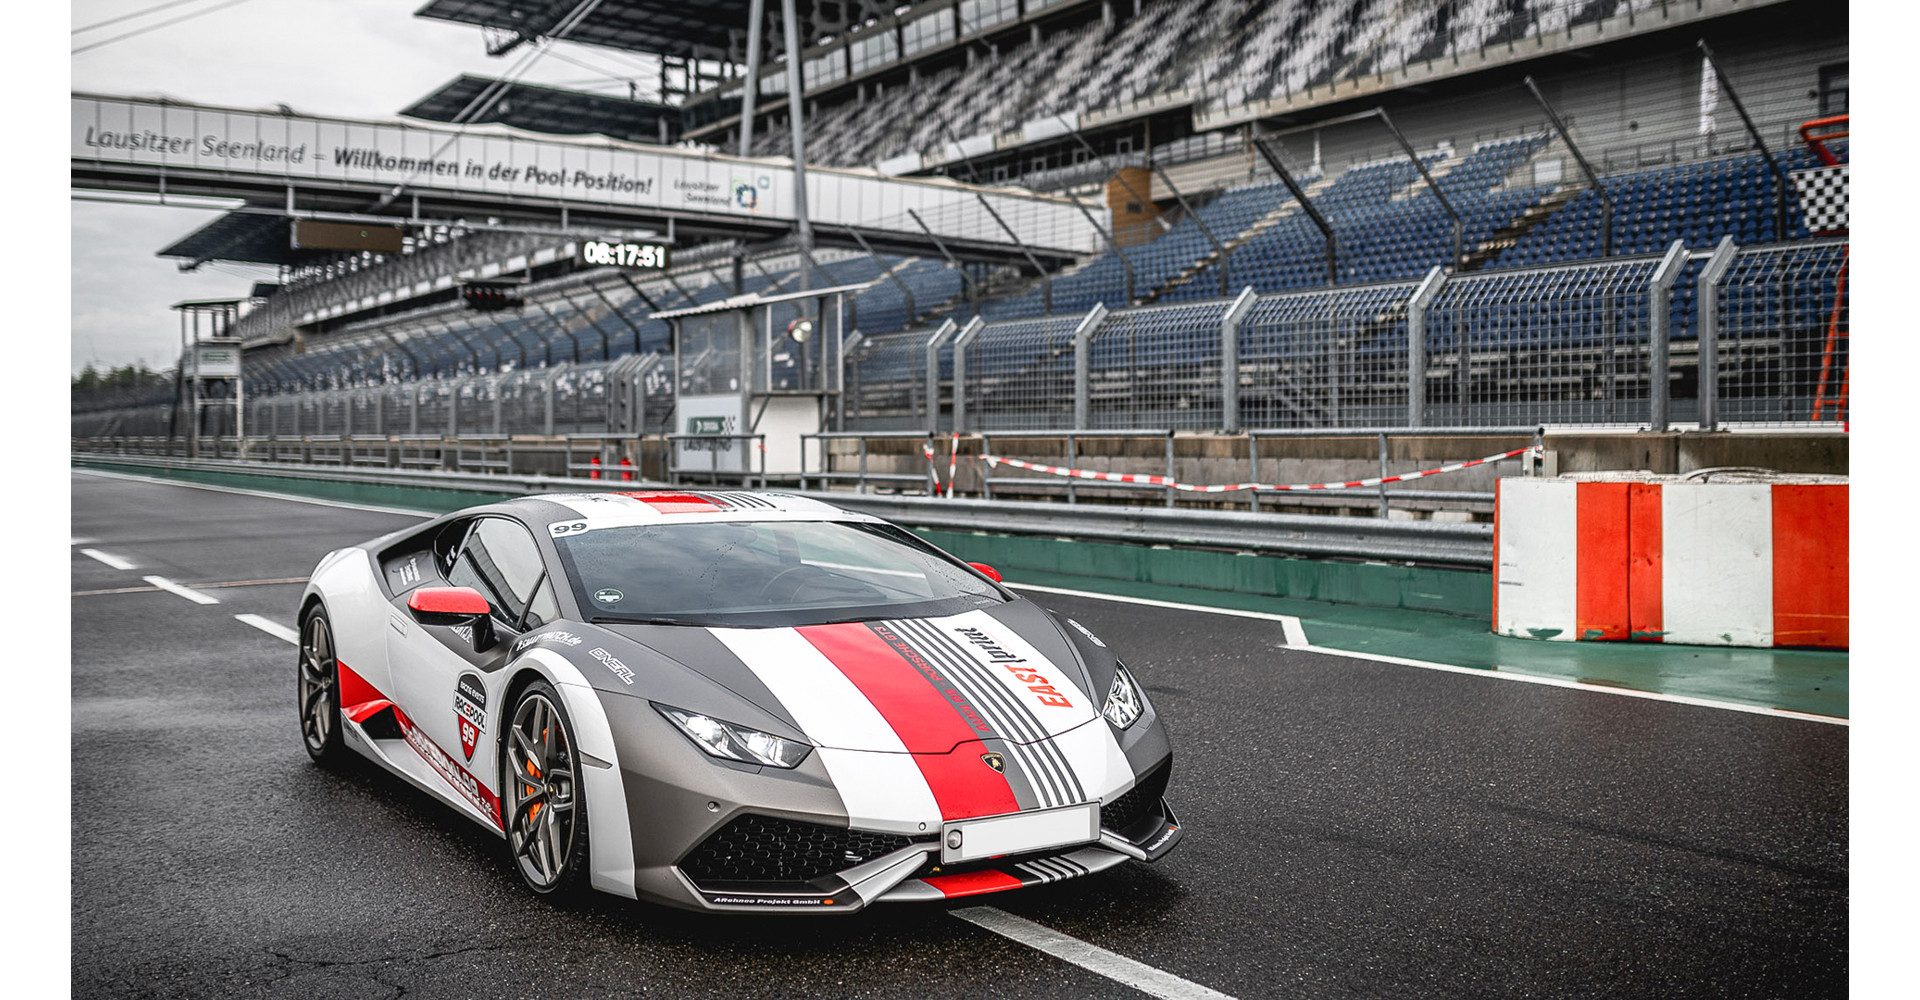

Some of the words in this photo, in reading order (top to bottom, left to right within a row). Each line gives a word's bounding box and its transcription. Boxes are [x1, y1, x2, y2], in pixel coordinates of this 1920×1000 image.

[85, 125, 195, 154] Lausitzer
[200, 134, 306, 164] Seenland
[334, 146, 460, 177] Willkommen
[465, 159, 484, 179] in
[489, 161, 520, 183] der
[525, 165, 653, 195] Pool-Position!
[553, 522, 587, 534] 99
[873, 626, 897, 642] GT3
[894, 641, 944, 682] PORSCHE
[944, 688, 965, 704] R8
[454, 695, 485, 730] RACEPOOL
[959, 704, 991, 733] AUDI
[462, 722, 475, 747] 99
[756, 898, 791, 906] Projekt
